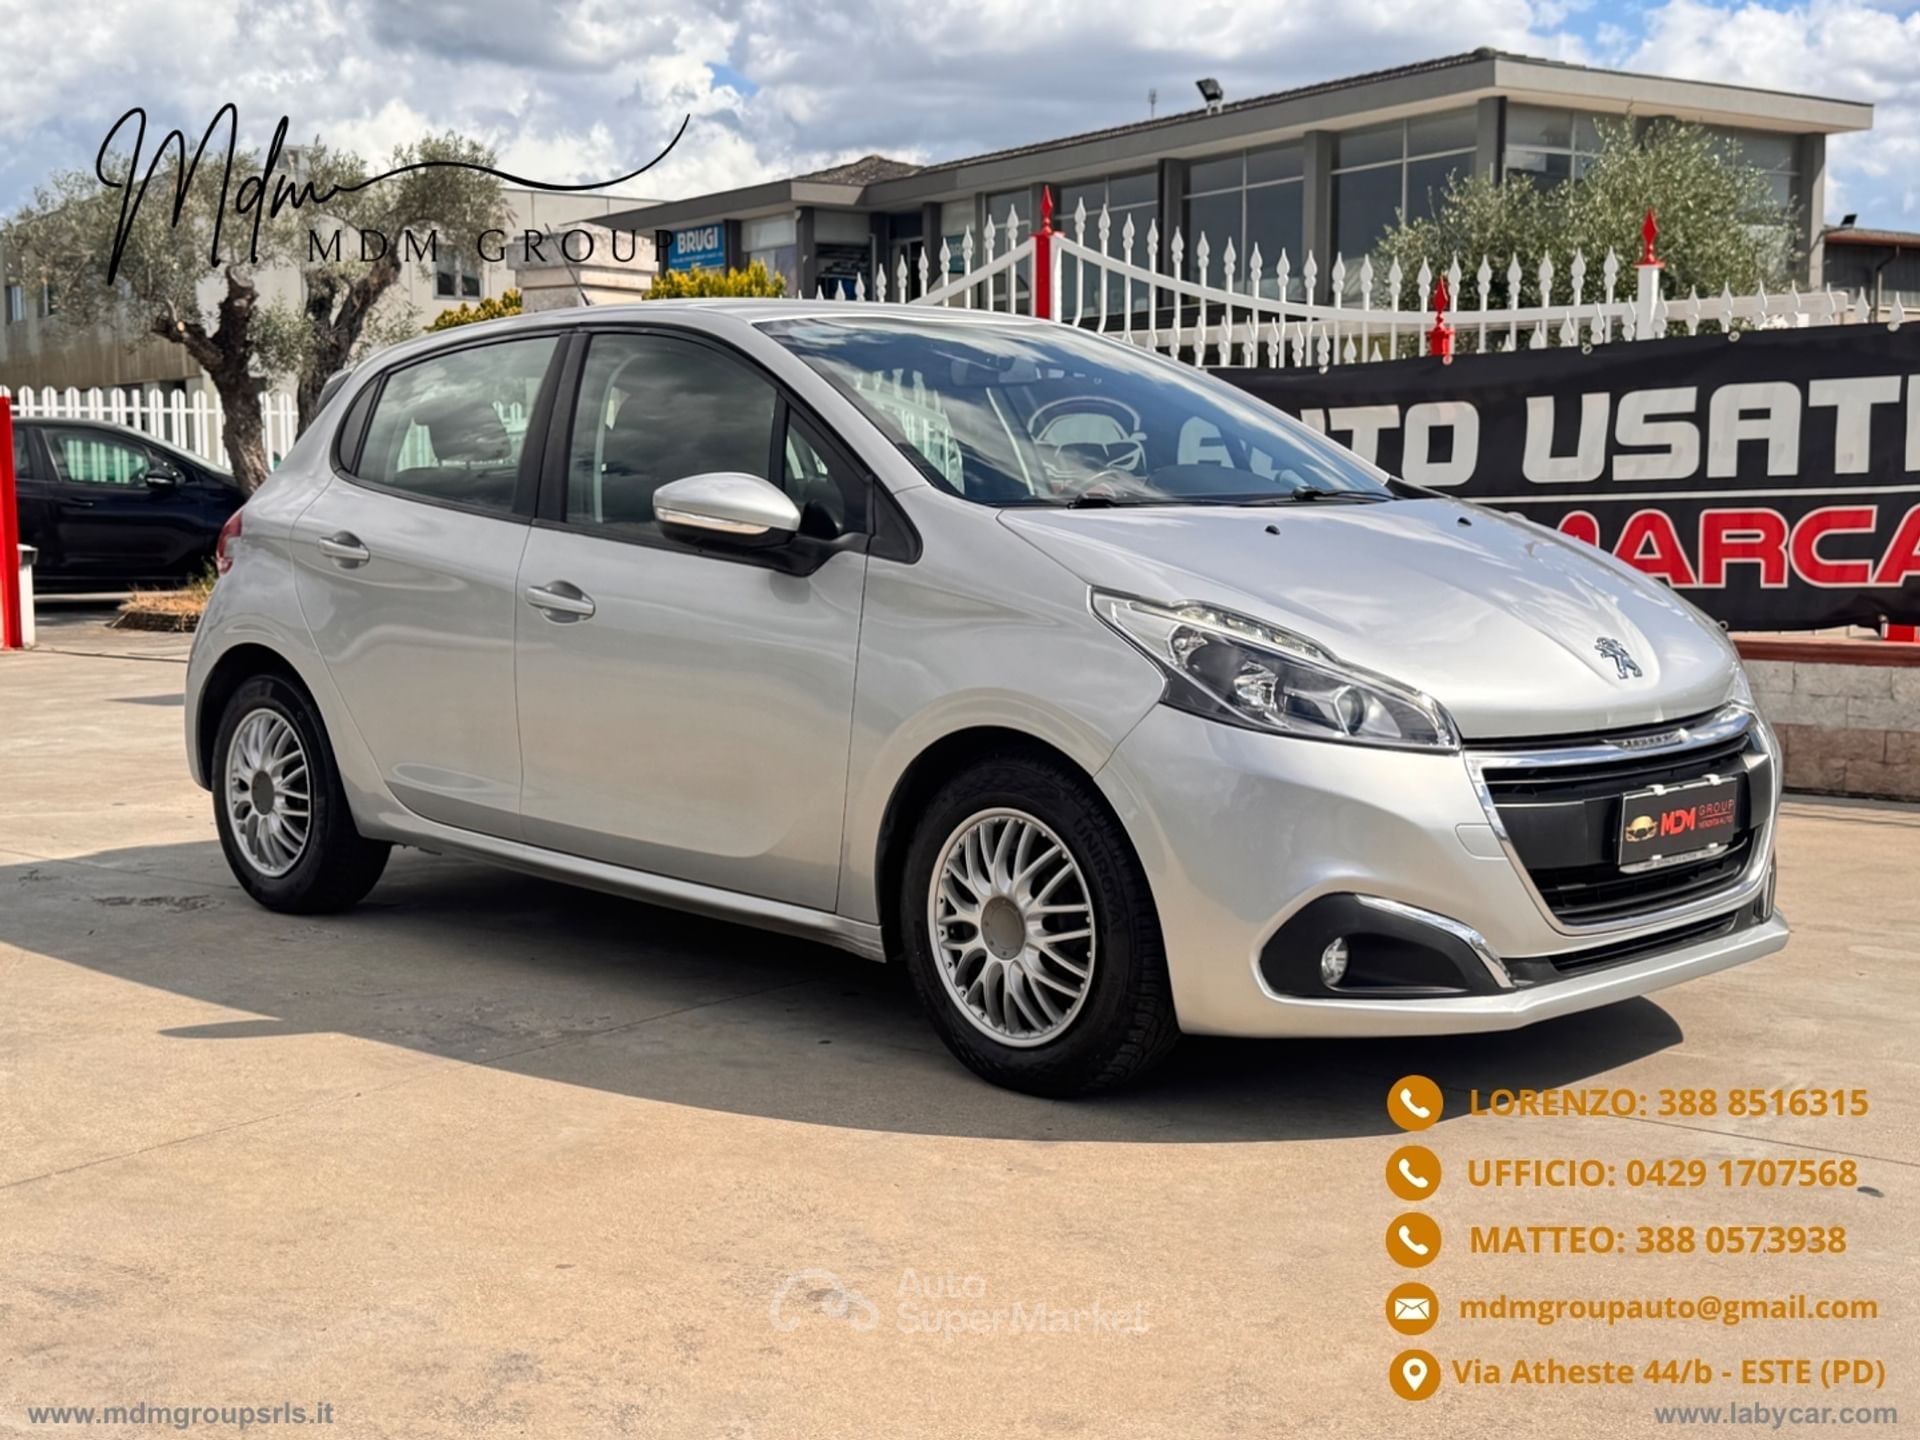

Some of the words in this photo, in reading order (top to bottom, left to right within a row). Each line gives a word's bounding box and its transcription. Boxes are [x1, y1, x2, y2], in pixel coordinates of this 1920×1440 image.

[677, 226, 719, 255] BRUGI
[1522, 374, 1920, 484] USAT
[1660, 807, 1697, 837] MDM
[1698, 799, 1735, 816] GROUP
